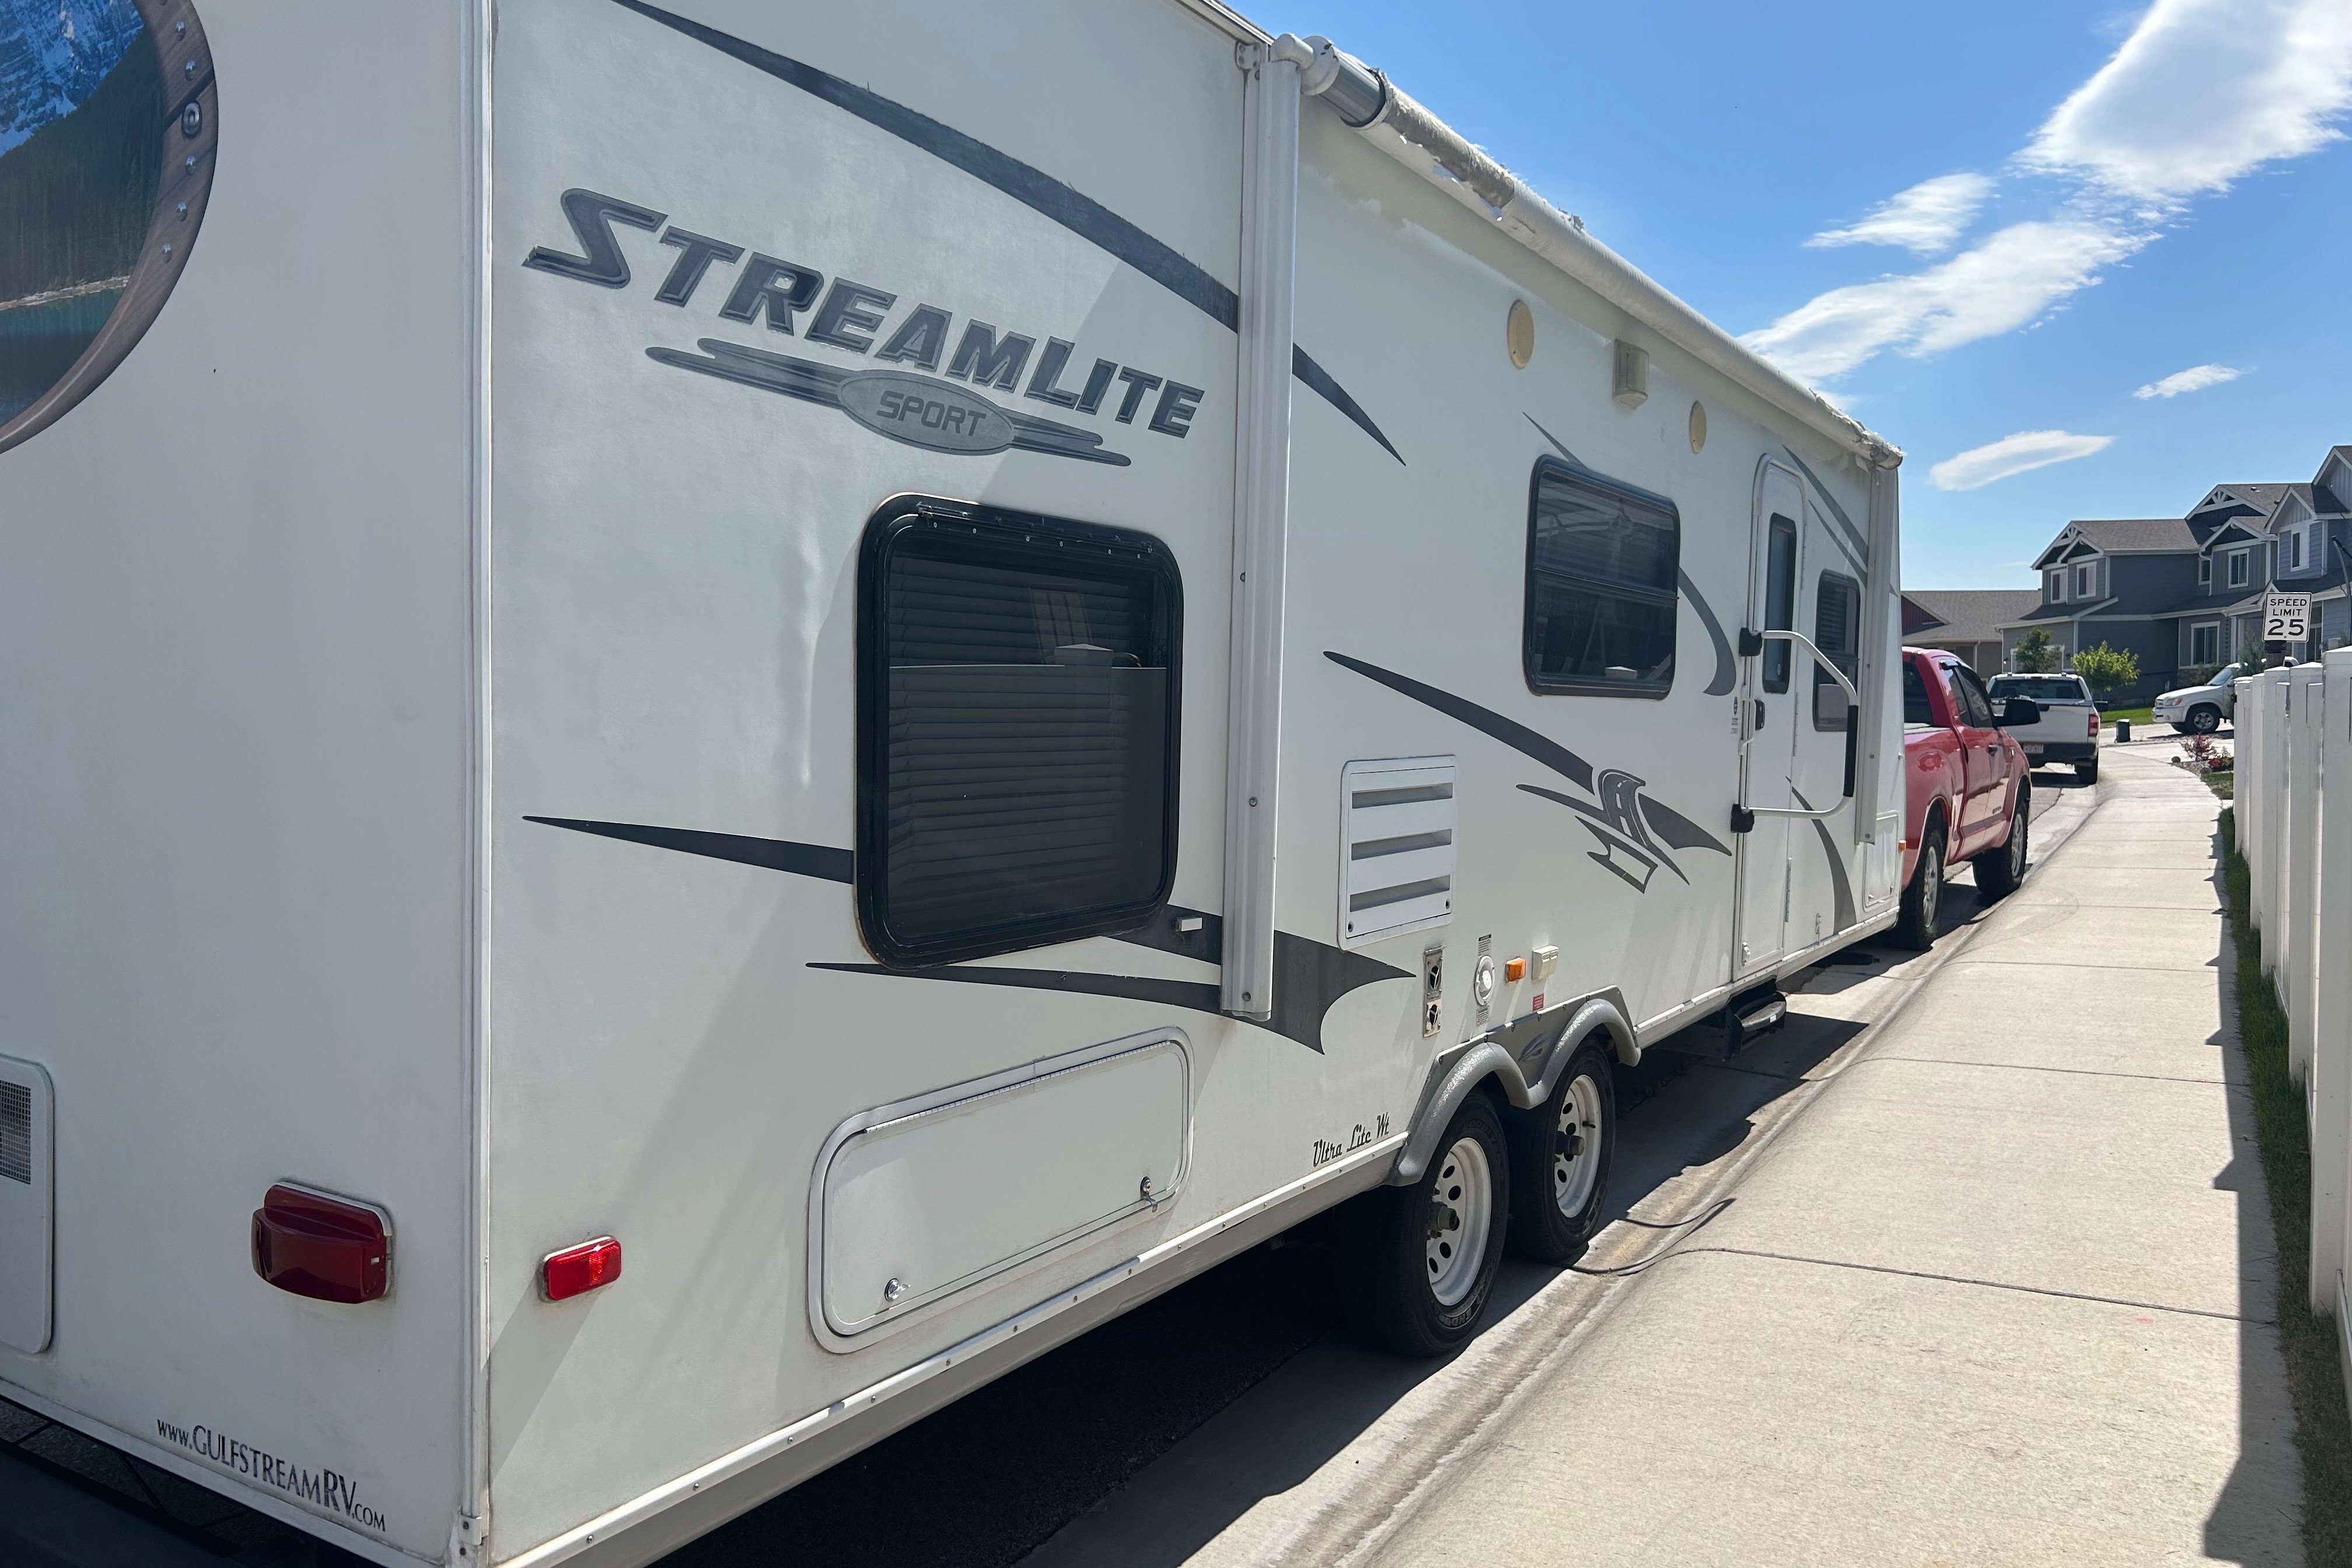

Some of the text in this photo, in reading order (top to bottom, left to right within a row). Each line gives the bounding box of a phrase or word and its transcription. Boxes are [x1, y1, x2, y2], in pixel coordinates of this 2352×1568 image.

[522, 188, 1205, 439] STREAMLITE
[877, 390, 986, 438] SPORT
[2267, 618, 2304, 636] 25
[1313, 1139, 1342, 1167] Ultra
[1346, 1124, 1371, 1153] Lite
